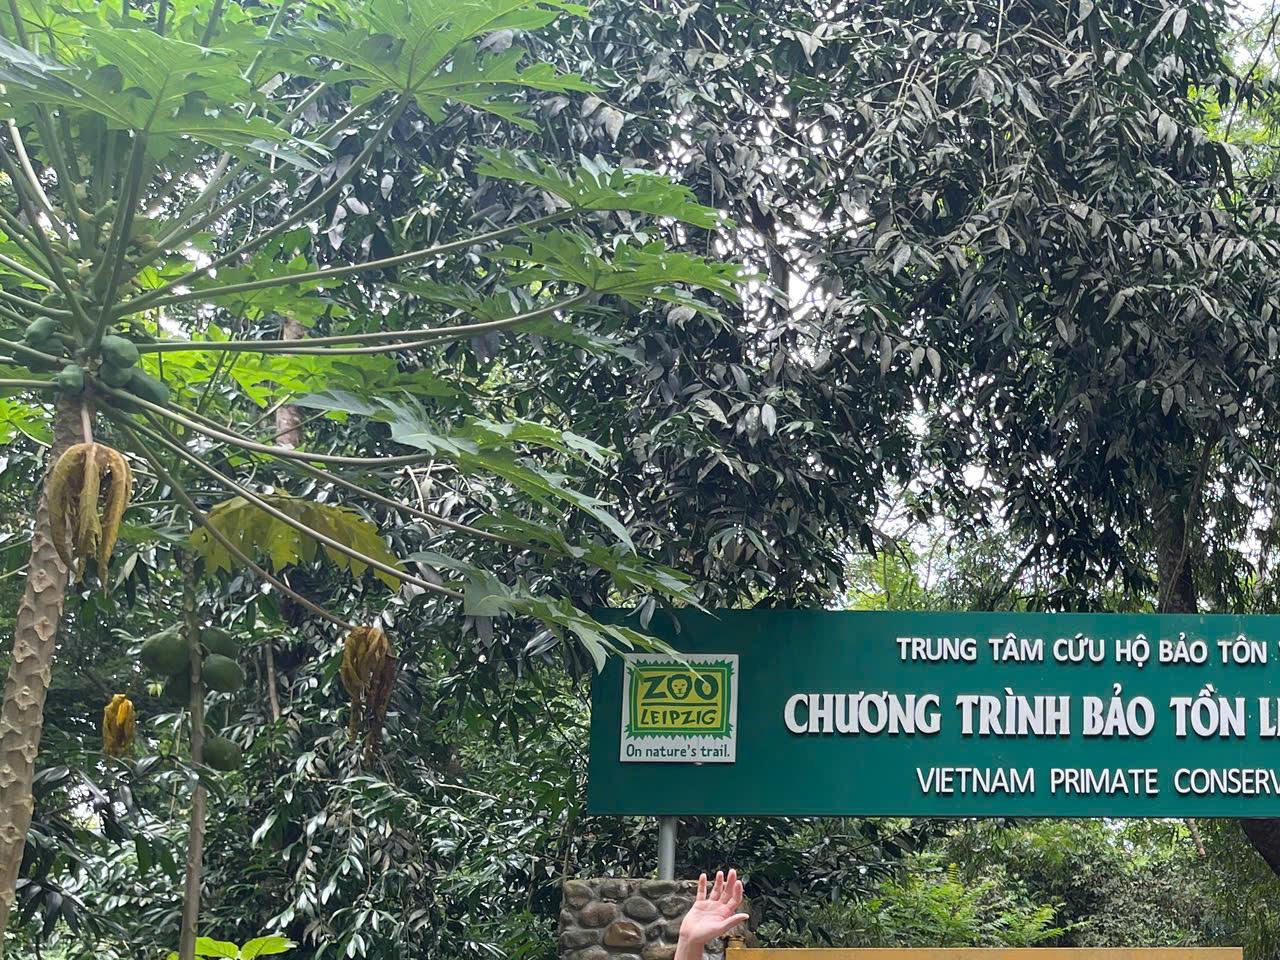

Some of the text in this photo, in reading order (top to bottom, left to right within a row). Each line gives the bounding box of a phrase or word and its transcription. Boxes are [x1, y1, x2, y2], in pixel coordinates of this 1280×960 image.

[896, 637, 978, 662] TRUNG
[988, 632, 1044, 662] TÂM
[1053, 632, 1106, 663] CỨU
[1115, 634, 1151, 668] HỘ
[1158, 631, 1209, 664] BẢO
[641, 673, 719, 701] ZOO
[640, 708, 718, 725] LEIPZIG
[783, 690, 942, 735] CHƯƠNG
[955, 687, 1072, 736] TRÌNH
[1082, 682, 1156, 737] BẢO
[1169, 683, 1247, 738] TỒN
[626, 743, 730, 758] On nature's trail.
[916, 767, 1035, 794] VIETNAM
[1050, 767, 1160, 795] PRIMATE
